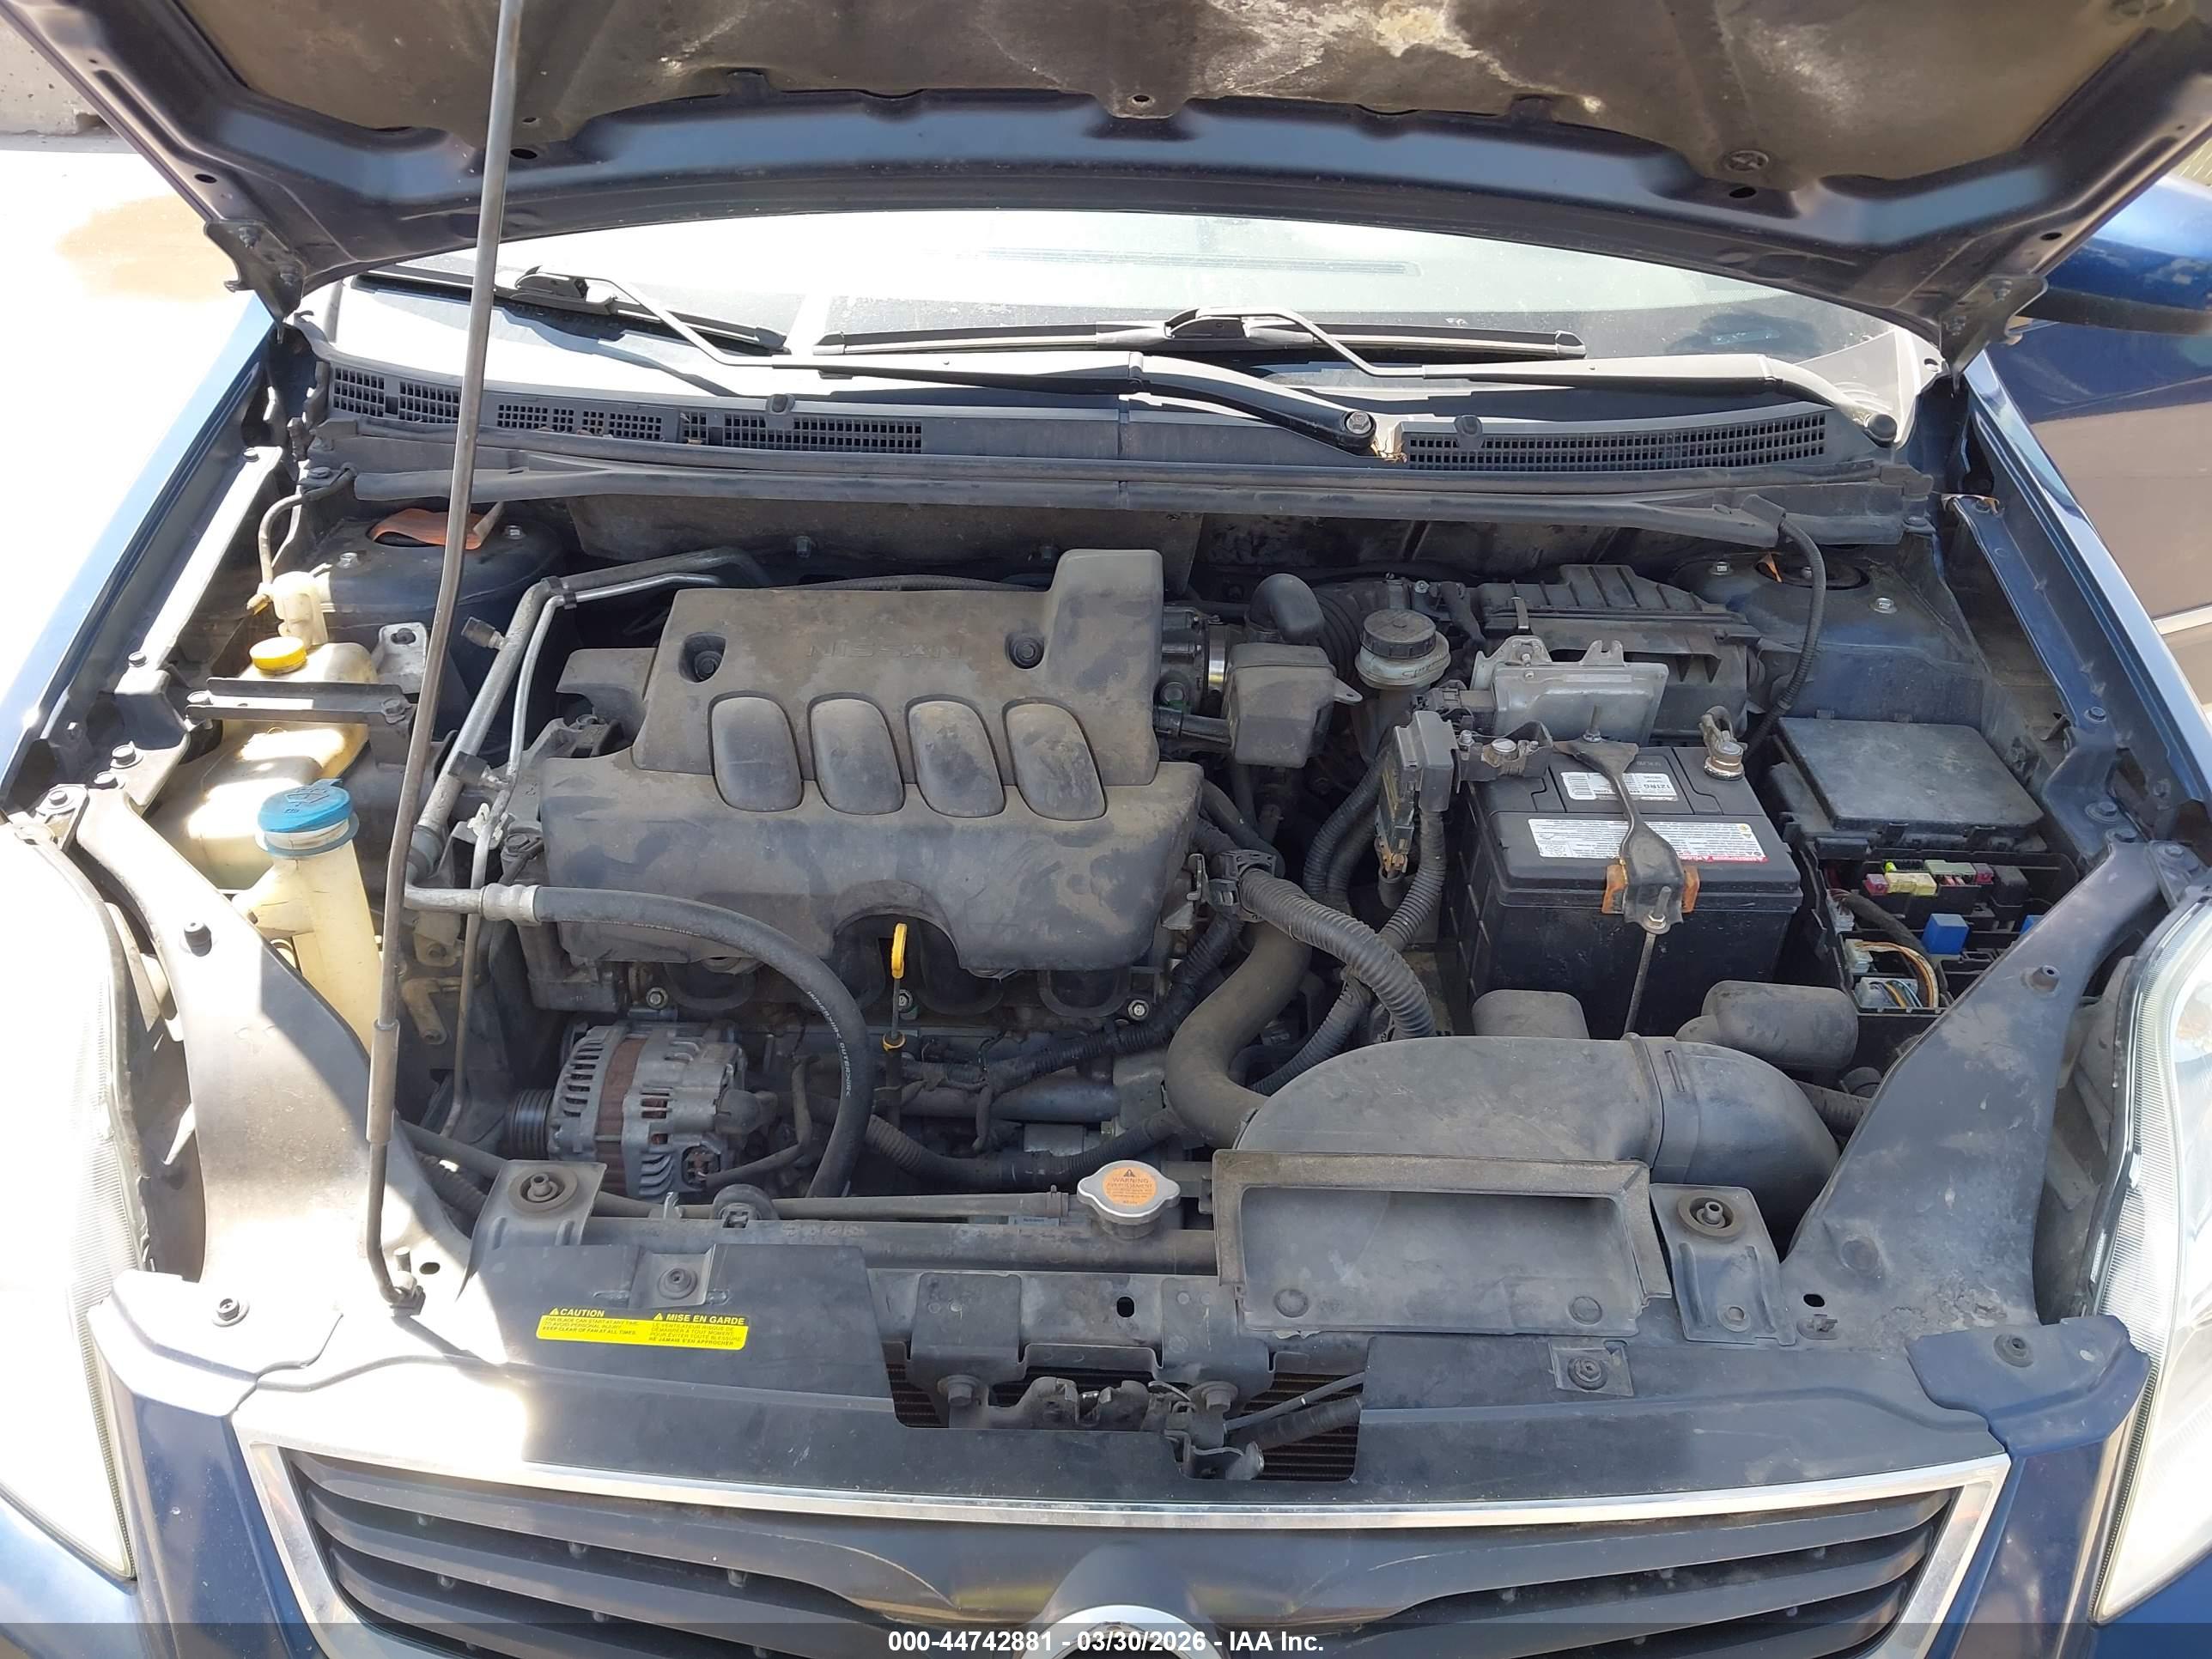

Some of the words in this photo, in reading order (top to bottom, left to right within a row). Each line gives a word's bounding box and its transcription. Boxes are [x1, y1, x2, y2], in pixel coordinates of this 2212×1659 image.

[807, 641, 962, 659] NISSAN
[560, 1308, 605, 1317] CAUTION
[709, 1316, 745, 1325] GARDE
